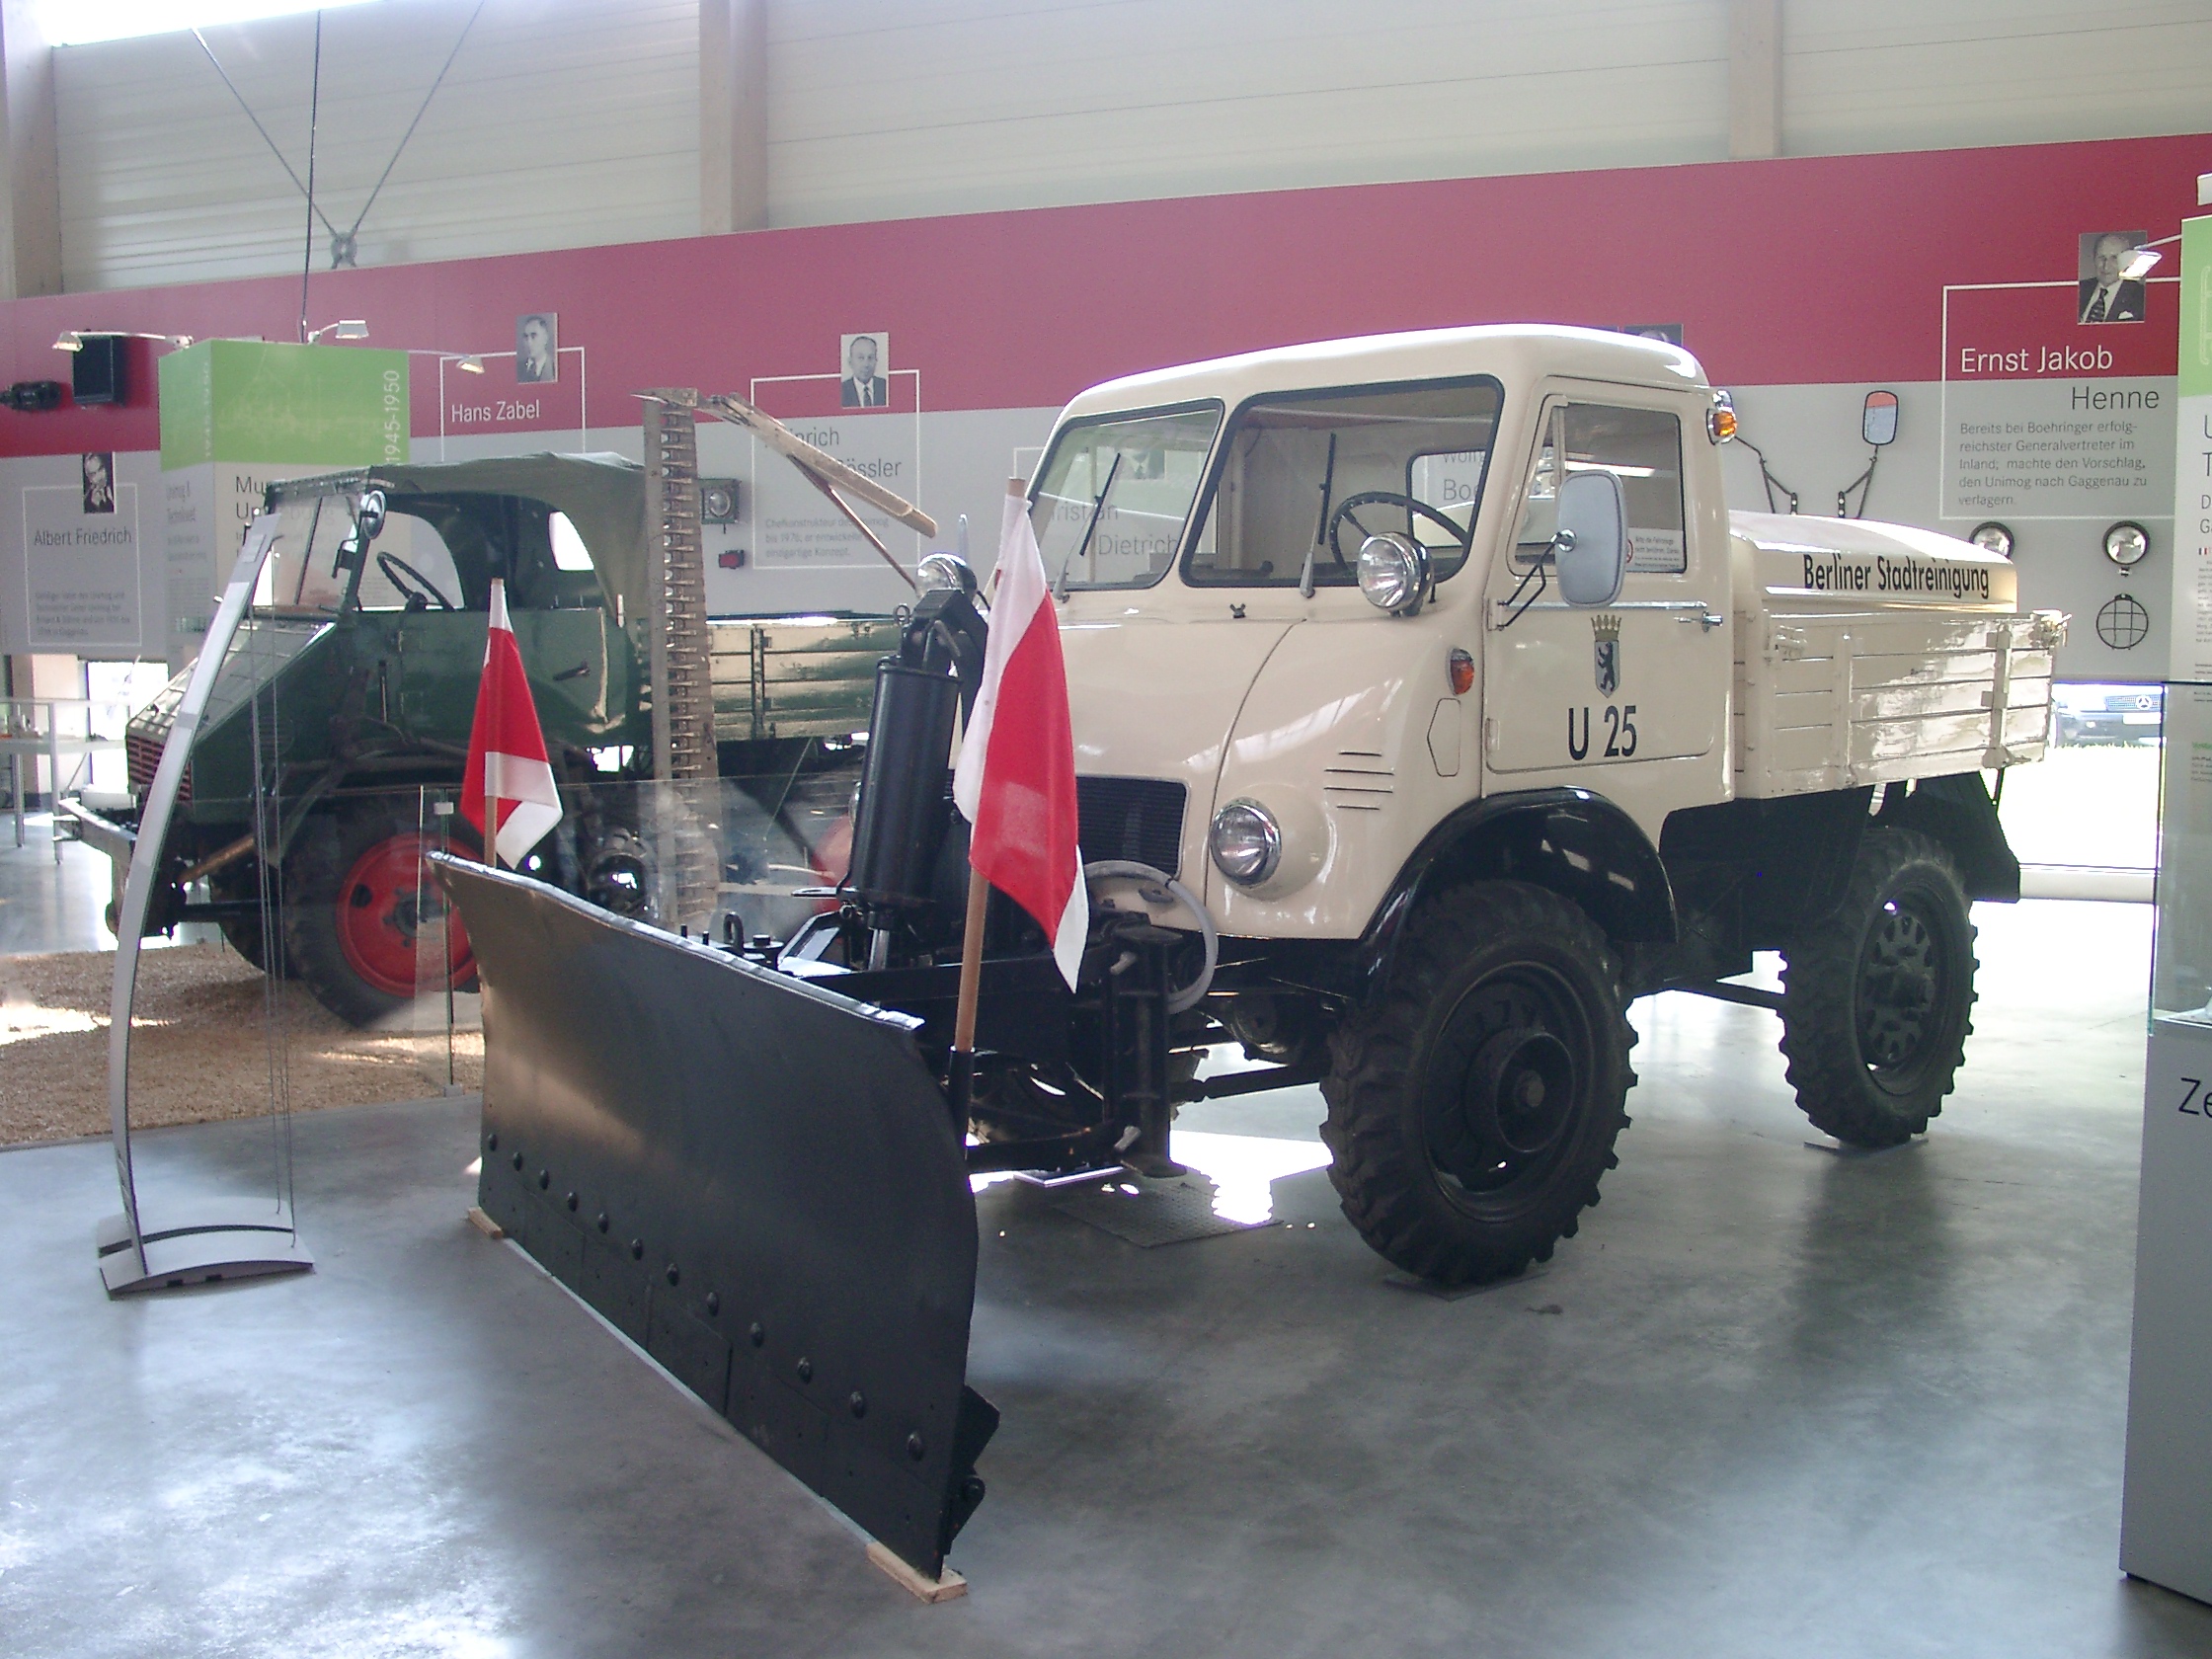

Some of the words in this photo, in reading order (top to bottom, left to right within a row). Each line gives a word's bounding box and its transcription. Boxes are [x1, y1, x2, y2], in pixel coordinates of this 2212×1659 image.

[1960, 348, 2029, 373] Ernst
[2037, 345, 2113, 373] Jakob
[2072, 385, 2160, 410] Henne
[451, 403, 492, 424] Hans
[496, 399, 540, 422] Zabel
[1960, 423, 2002, 434] Bereits
[2006, 423, 2023, 434] bei
[2027, 422, 2094, 434] Boehringer
[1959, 440, 2013, 452] reichster
[2015, 439, 2115, 451] Generalvertreter
[2119, 438, 2134, 450] im
[2007, 458, 2052, 469] machte
[2055, 458, 2079, 469] den
[1958, 476, 1981, 488] den
[1985, 476, 2031, 489] Unimog
[2035, 476, 2064, 486] nach
[2068, 475, 2129, 489] Gaggenau
[2133, 476, 2147, 486] zu
[34, 528, 72, 546] Albert
[75, 525, 132, 545] Friedrich
[1803, 553, 1871, 590] Berliner
[1877, 555, 1989, 599] Stadtreinigung
[1568, 707, 1589, 760] U
[1604, 705, 1637, 757] 25
